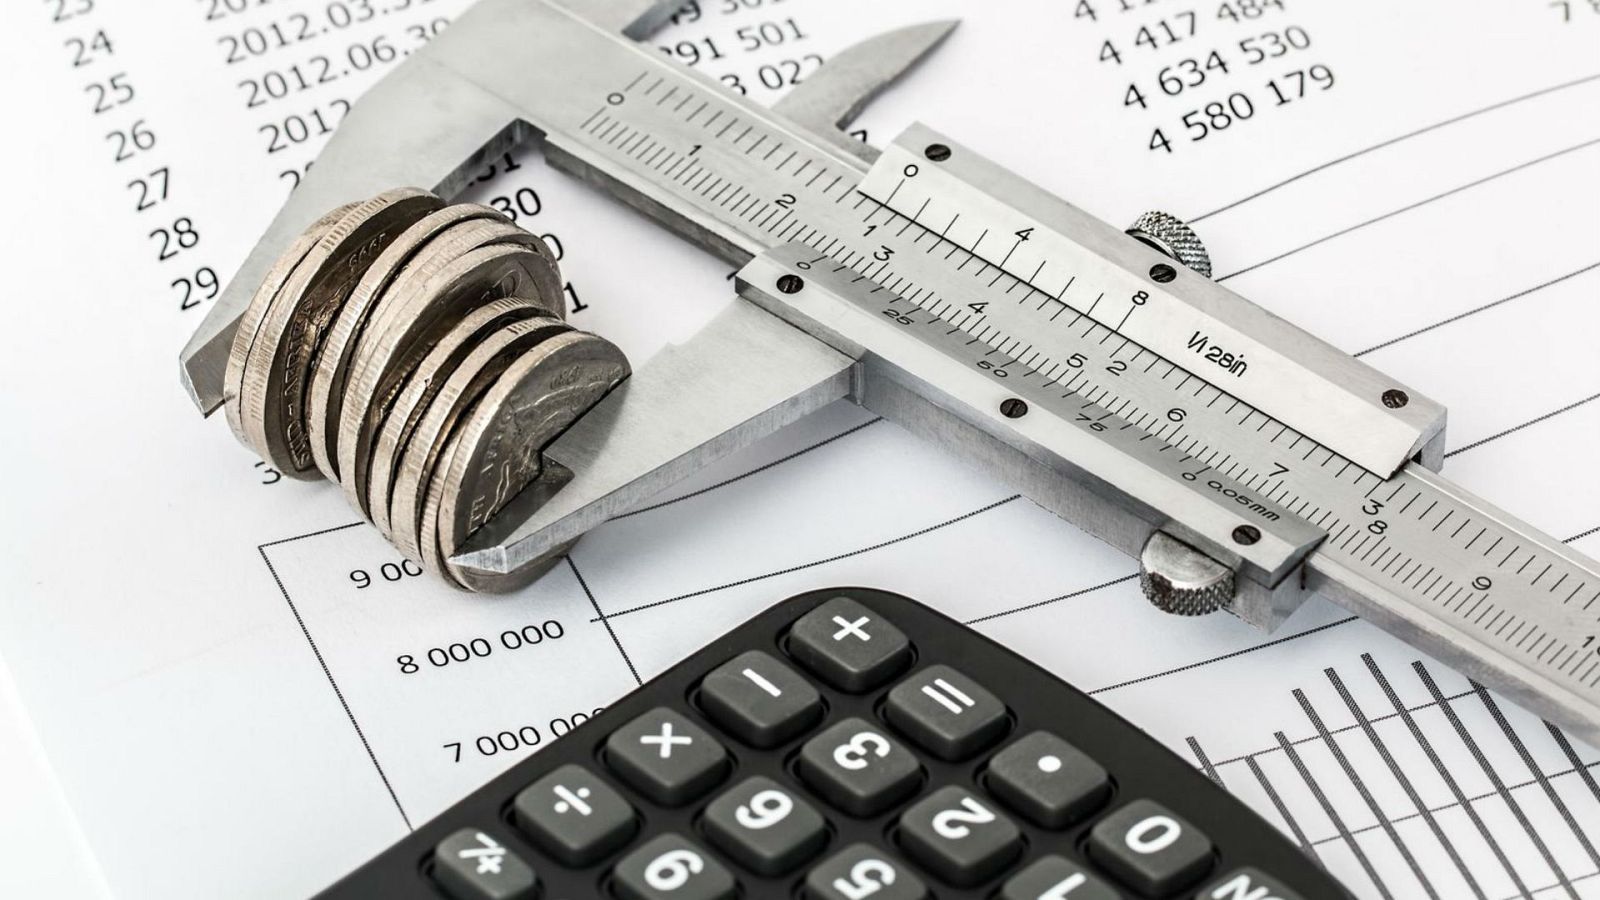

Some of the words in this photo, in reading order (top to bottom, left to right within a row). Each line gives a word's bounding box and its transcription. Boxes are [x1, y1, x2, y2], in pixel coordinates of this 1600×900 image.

[64, 29, 114, 67] 24
[217, 0, 434, 63] 2012.03.
[736, 18, 808, 51] 501
[1099, 40, 1123, 65] 4
[1134, 11, 1196, 49] 417
[1124, 84, 1147, 109] 4
[1157, 50, 1229, 96] 634
[1238, 25, 1311, 64] 530
[84, 72, 135, 114] 25
[1149, 128, 1172, 153] 4
[1181, 92, 1254, 141] 580
[1266, 64, 1334, 106] 179
[105, 119, 156, 162] 26
[127, 167, 169, 211] 27
[149, 216, 199, 261] 28
[171, 266, 219, 311] 29
[1014, 227, 1035, 242] 4
[1131, 290, 1149, 306] 8
[775, 193, 797, 209] 2
[873, 245, 895, 262] 3
[968, 301, 989, 315] 4
[1066, 353, 1088, 368] 5
[1167, 408, 1187, 422] 6
[1268, 462, 1290, 477] 7
[1367, 520, 1388, 535] 8
[1471, 576, 1492, 591] 9
[882, 308, 915, 326] 25
[976, 360, 1008, 378] 50
[1075, 413, 1108, 432] 75
[1105, 360, 1128, 376] 2
[1362, 498, 1385, 516] 3
[350, 569, 371, 589] 9
[397, 655, 419, 674] 8
[428, 638, 492, 667] 000
[500, 619, 565, 650] 000
[443, 742, 462, 763] 7
[476, 726, 541, 756] 000
[549, 708, 606, 737] 00
[833, 732, 890, 769] 3
[932, 796, 996, 839] 2
[832, 859, 896, 900] 5
